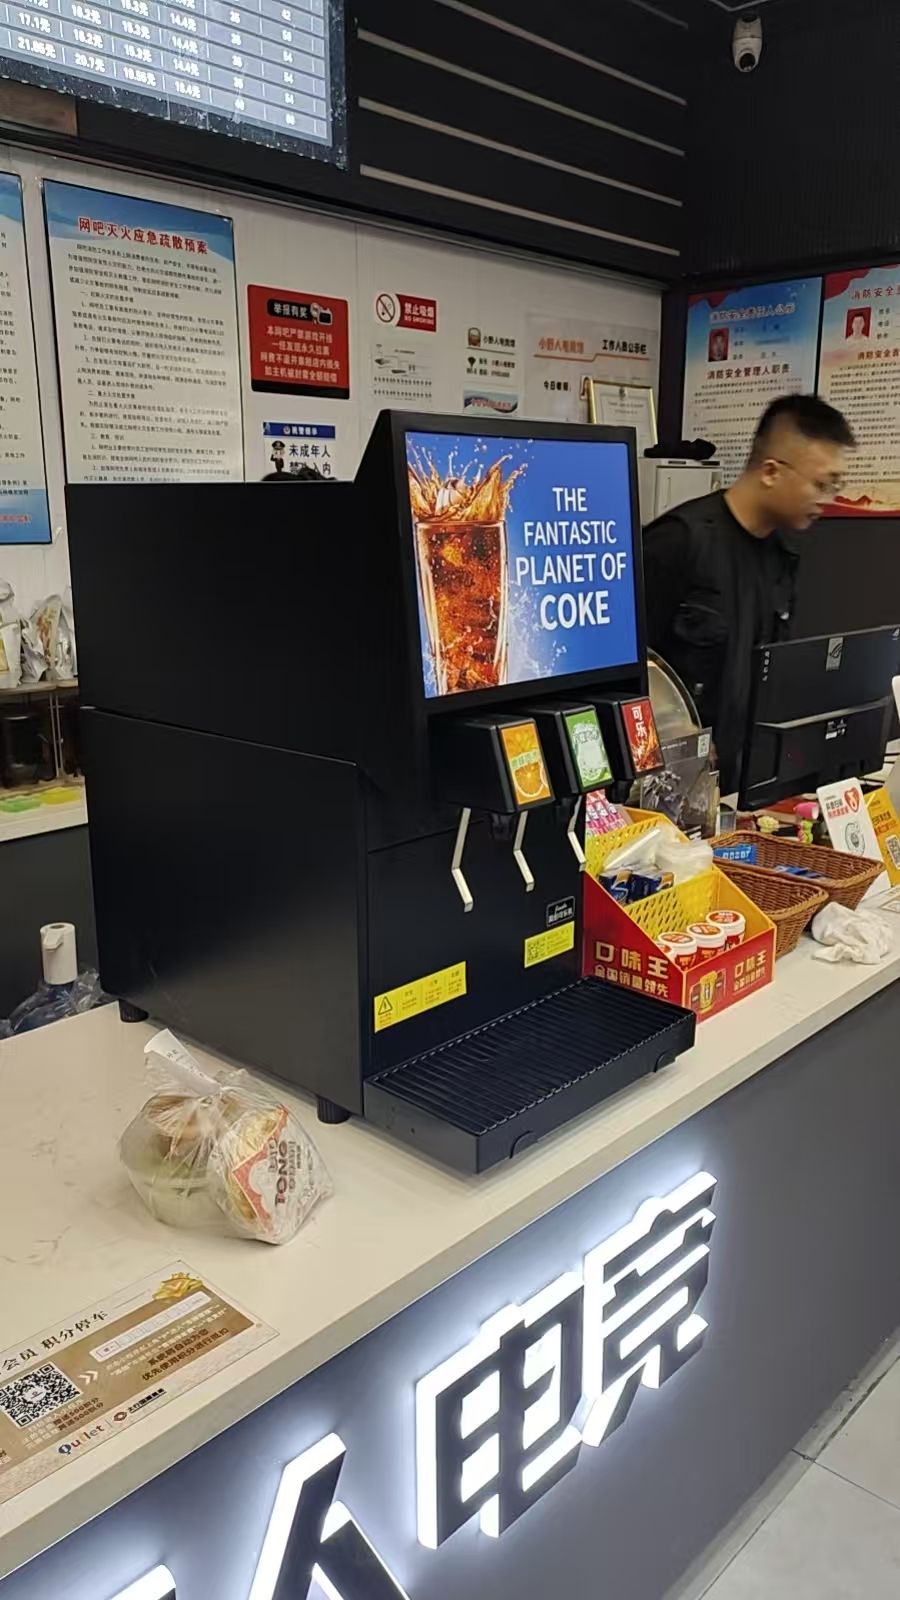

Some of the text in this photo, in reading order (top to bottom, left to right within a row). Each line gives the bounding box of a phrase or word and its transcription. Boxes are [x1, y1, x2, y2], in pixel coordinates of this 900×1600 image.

[19, 12, 51, 33] 17.1元
[74, 53, 106, 73] 20.7元
[78, 215, 208, 255] 网吧灭火应急疏散预案
[273, 302, 308, 319] 举报有奖
[403, 302, 435, 319] 禁止吸烟
[707, 363, 790, 380] 消防安全管理人职责
[288, 444, 331, 458] 未成年人
[552, 487, 588, 512] THE
[523, 520, 617, 547] FANTASTIC
[515, 552, 627, 586] PLANET OF
[540, 590, 611, 631] COKE
[595, 941, 669, 980] 口味王
[734, 949, 767, 978] 口味王
[594, 964, 669, 998] 全国销量领先
[1, 1348, 39, 1371] 会员
[40, 1311, 108, 1350] 积分停车
[141, 1327, 230, 1382] 优先使用积分进行抵扣
[108, 1170, 718, 1600] 人电竞
